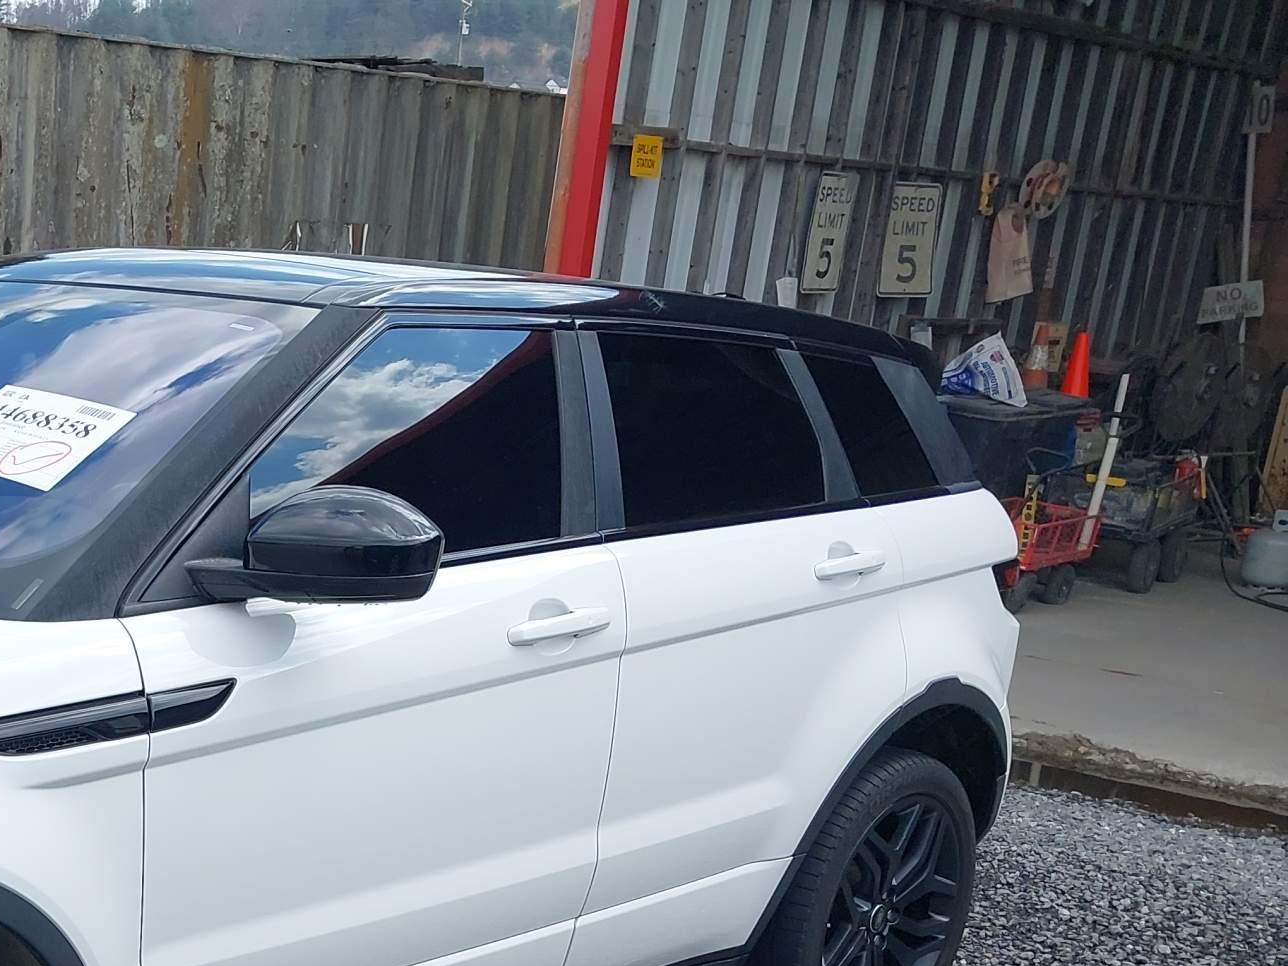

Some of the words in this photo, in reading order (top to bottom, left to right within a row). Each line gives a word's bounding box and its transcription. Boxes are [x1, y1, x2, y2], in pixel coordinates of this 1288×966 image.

[819, 186, 853, 204] SPEED
[891, 195, 936, 213] SPEED
[817, 212, 846, 229] LIMIT
[892, 220, 928, 237] LIMIT
[815, 238, 835, 279] 5
[895, 244, 917, 284] 5
[1216, 287, 1242, 302] NO
